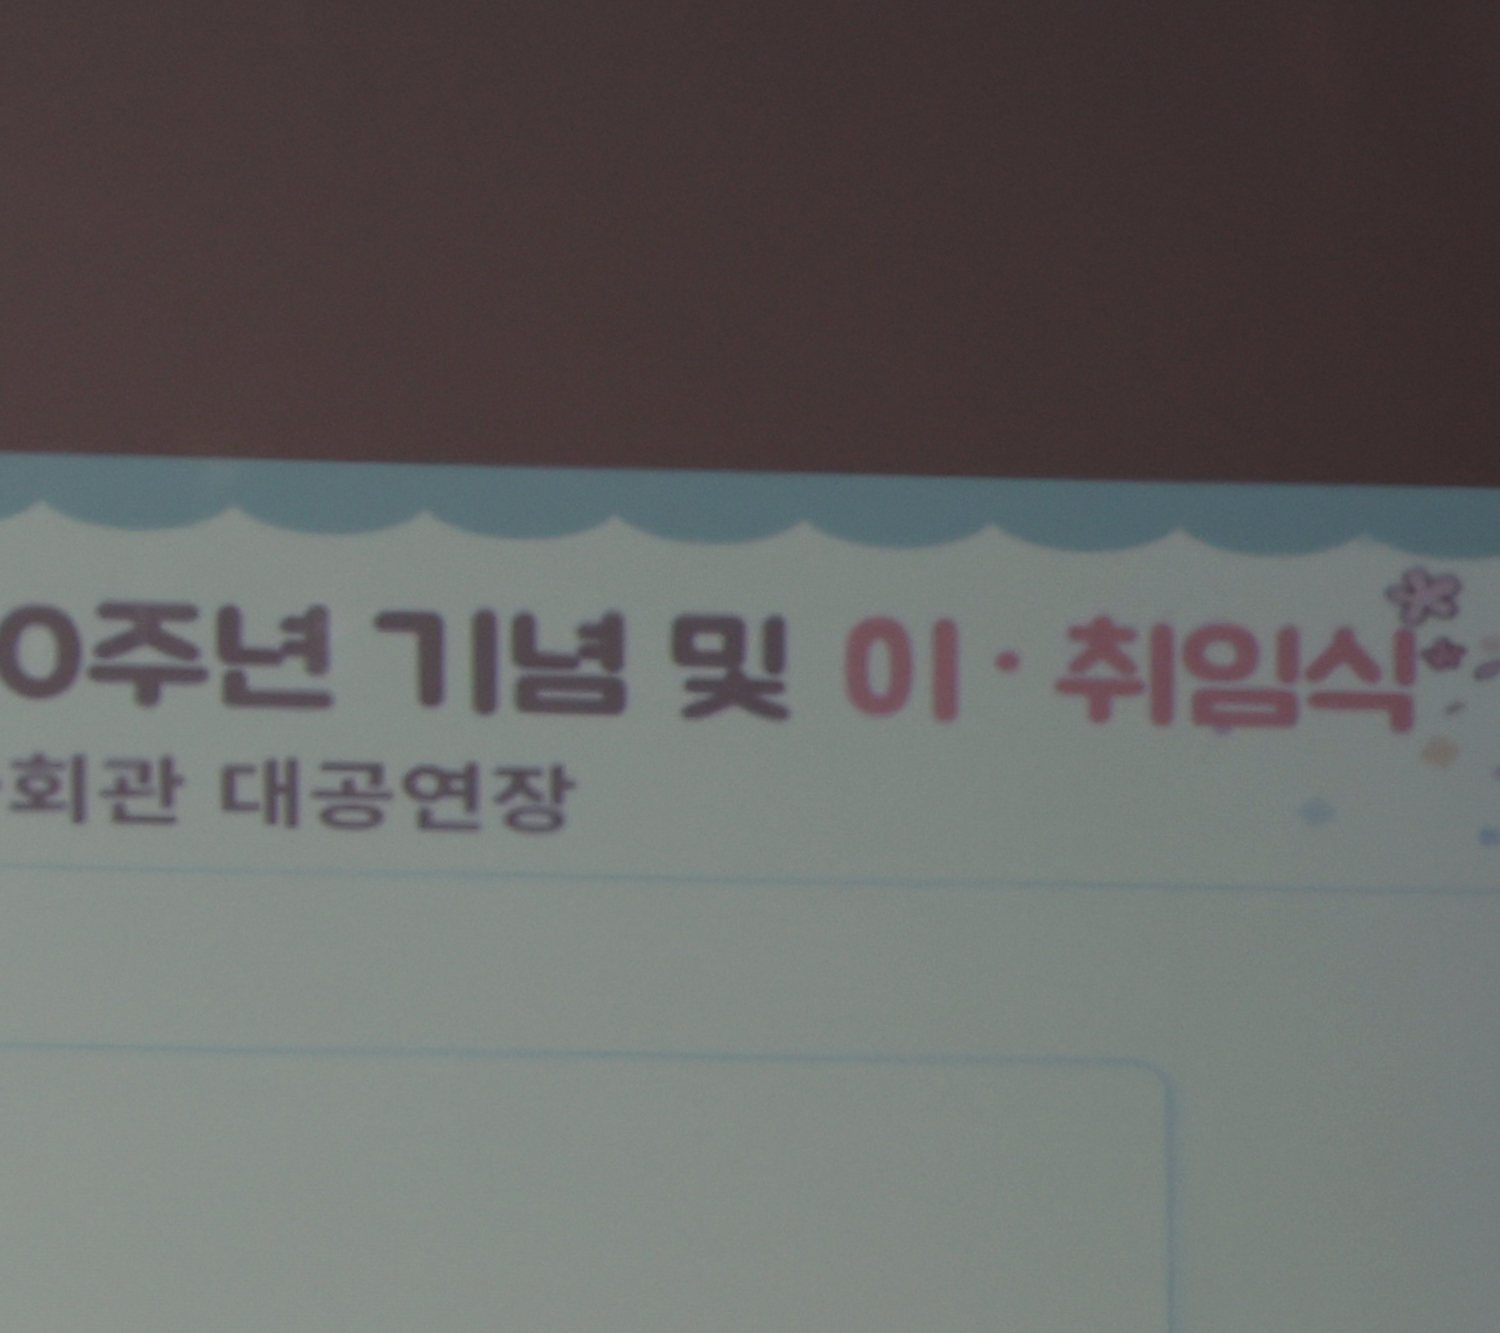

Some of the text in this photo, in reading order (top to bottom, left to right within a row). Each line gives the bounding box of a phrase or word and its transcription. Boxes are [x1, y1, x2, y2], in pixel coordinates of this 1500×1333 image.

[373, 609, 628, 716] 기념
[670, 614, 790, 720] 및
[220, 757, 576, 834] 대공연장
